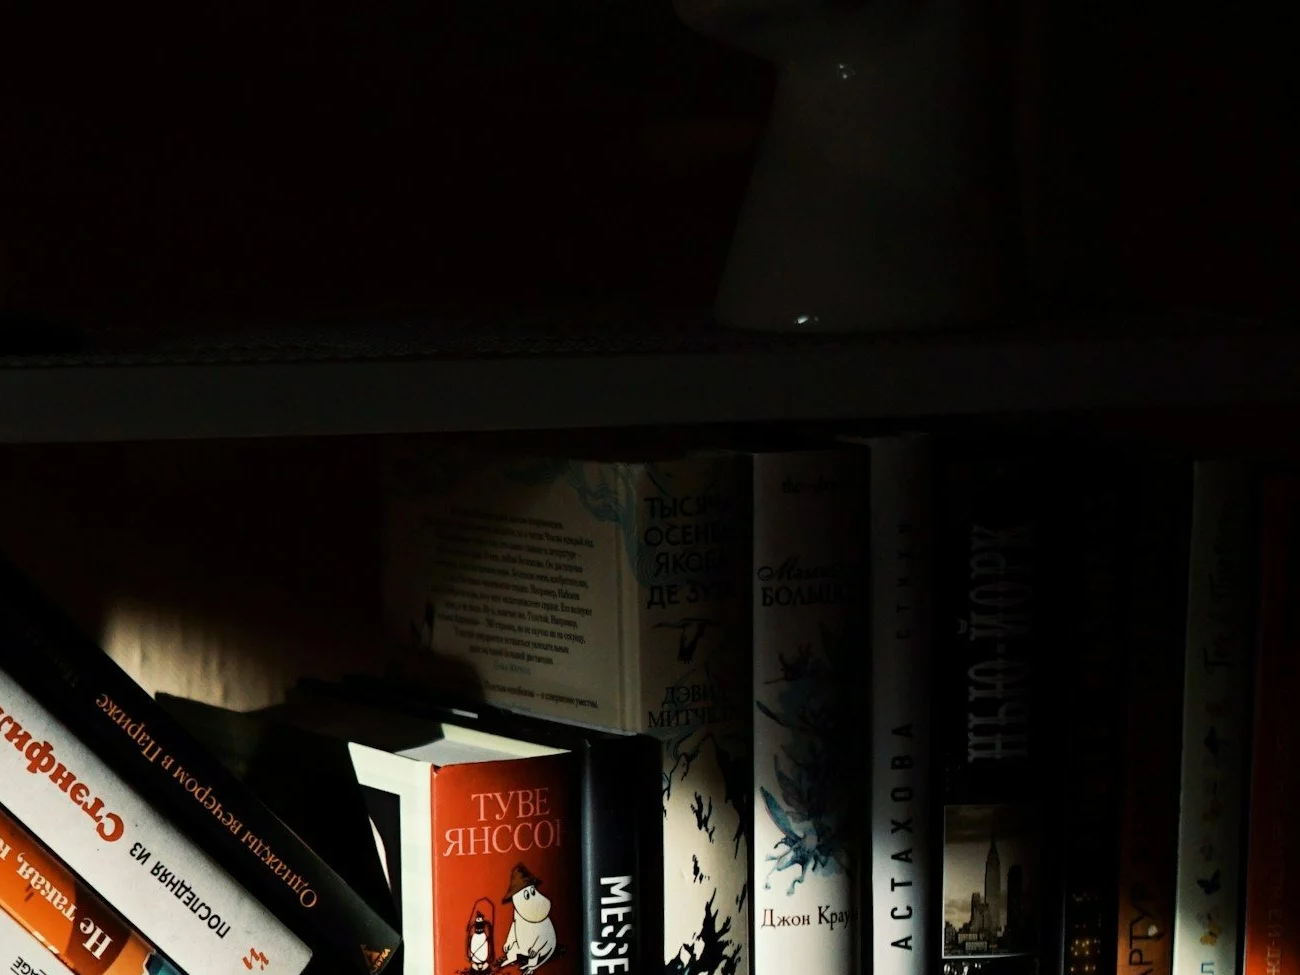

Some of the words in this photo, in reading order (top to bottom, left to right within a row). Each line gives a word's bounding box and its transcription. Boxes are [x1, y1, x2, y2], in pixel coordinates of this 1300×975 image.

[96, 693, 163, 756] Париже
[161, 754, 172, 770] в
[172, 764, 242, 836] вечером
[471, 788, 550, 823] ТУВЕ
[129, 842, 151, 866] ИЗ
[240, 828, 318, 909] Однажды
[890, 723, 914, 951] АСТАХОВА
[13, 852, 78, 923] такая,
[150, 861, 231, 939] ПОСЛЕДНЯЯ
[763, 907, 812, 928] Джон
[79, 917, 114, 960] Не
